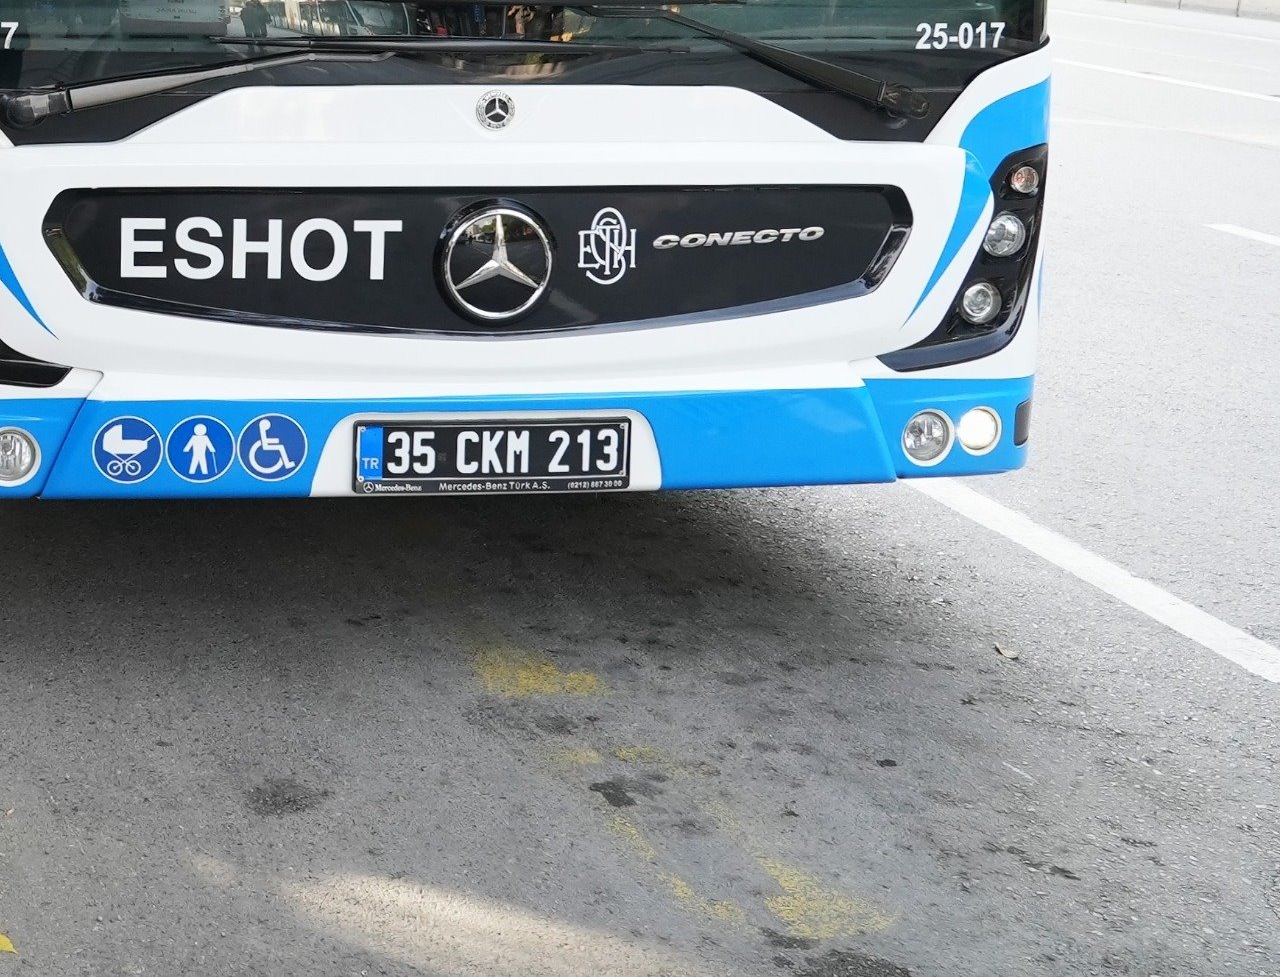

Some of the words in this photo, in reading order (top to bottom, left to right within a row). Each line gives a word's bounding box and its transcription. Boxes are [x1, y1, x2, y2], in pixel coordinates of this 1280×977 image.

[915, 21, 1006, 50] 25-017
[120, 216, 403, 282] ESHOT
[652, 226, 825, 250] CONECTO
[386, 431, 436, 474] 35
[456, 430, 530, 474] CKM
[547, 428, 619, 473] 213
[361, 457, 379, 470] TR
[374, 483, 423, 492] Mercedes-Benz
[439, 481, 507, 492] Mercedes-Benz
